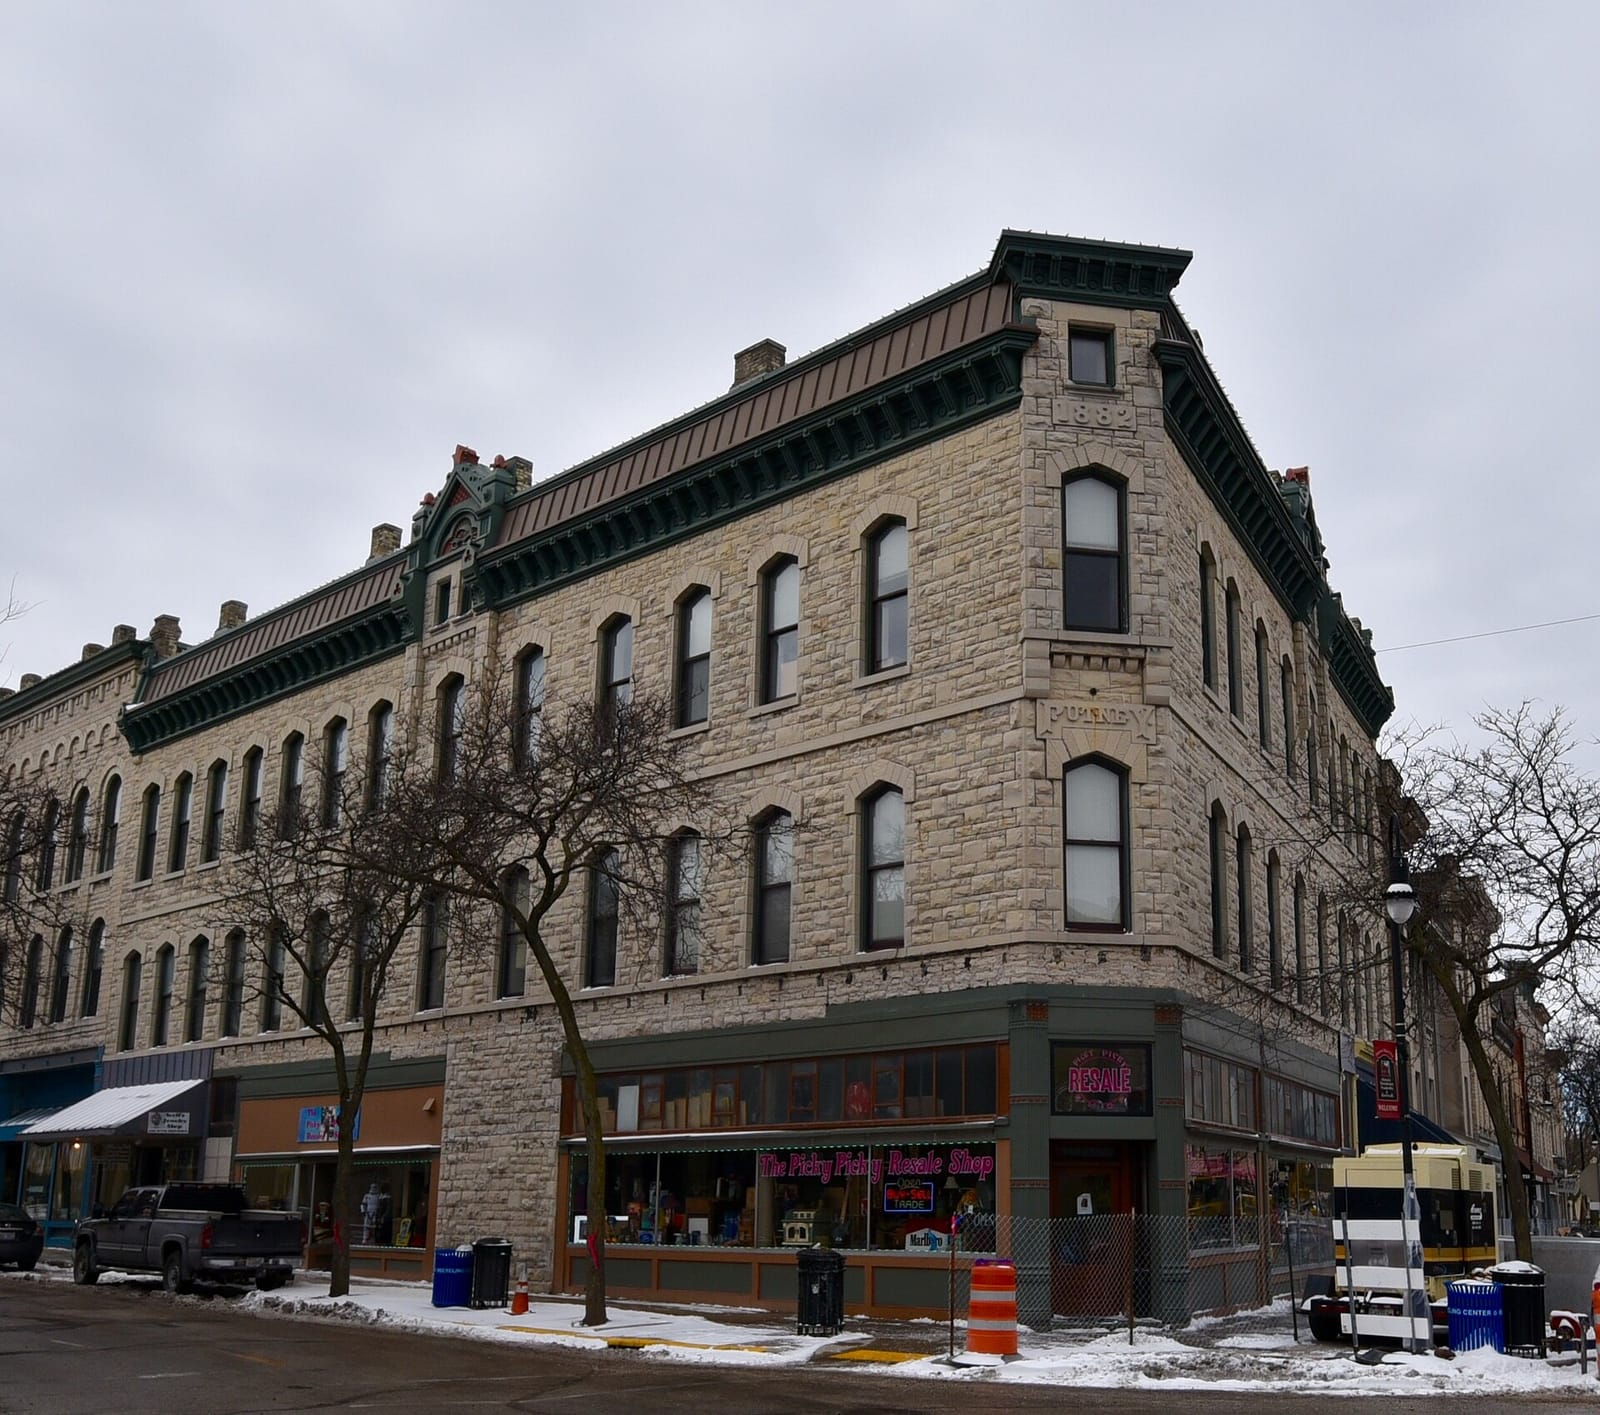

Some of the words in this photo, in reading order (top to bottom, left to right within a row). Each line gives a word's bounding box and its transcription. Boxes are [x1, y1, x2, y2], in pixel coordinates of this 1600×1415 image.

[1057, 400, 1132, 428] 1882
[1039, 700, 1155, 740] PUTNEY
[1068, 1066, 1132, 1093] RESALE
[759, 1153, 786, 1178] The
[788, 1152, 833, 1184] Picky
[834, 1151, 882, 1184] Picky
[888, 1149, 943, 1176] Resale
[948, 1148, 994, 1182] Shop
[894, 1199, 926, 1210] TRADE
[909, 1232, 943, 1247] Marlbro
[1463, 1308, 1492, 1317] CENTER
